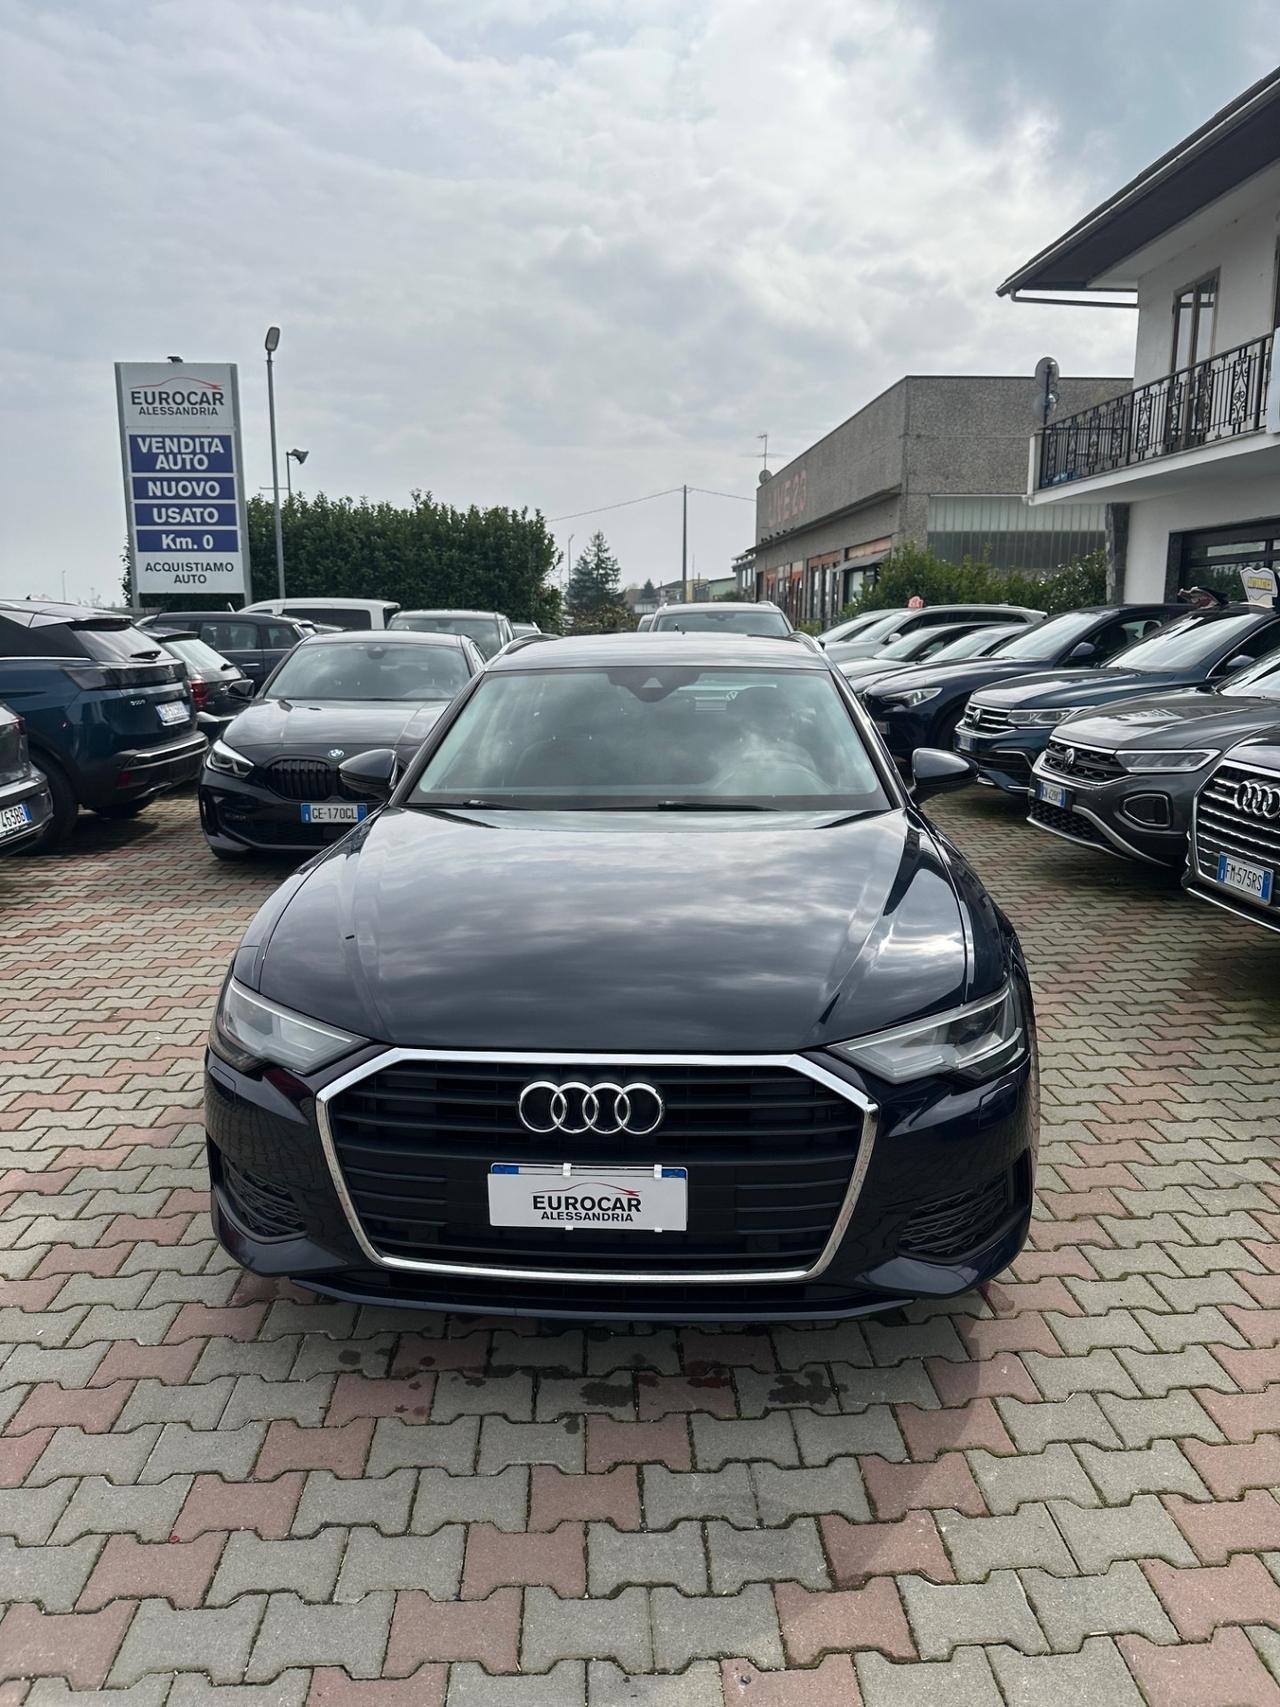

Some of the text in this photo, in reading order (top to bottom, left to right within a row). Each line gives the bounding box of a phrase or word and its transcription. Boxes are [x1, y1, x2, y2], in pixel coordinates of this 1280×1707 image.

[131, 391, 225, 406] EUROCAR
[138, 406, 219, 416] ALESSANDRIA
[137, 437, 224, 454] VENDITA
[155, 454, 209, 471] AUTO
[147, 481, 220, 497] NUOVO
[152, 507, 219, 524] USATO
[162, 534, 214, 550] Km. 0
[144, 562, 234, 573] ACQUISTIAMO
[173, 574, 207, 584] AUTO
[532, 1195, 642, 1213] EUROCAR
[541, 1211, 634, 1222] ALESSANDRIA
